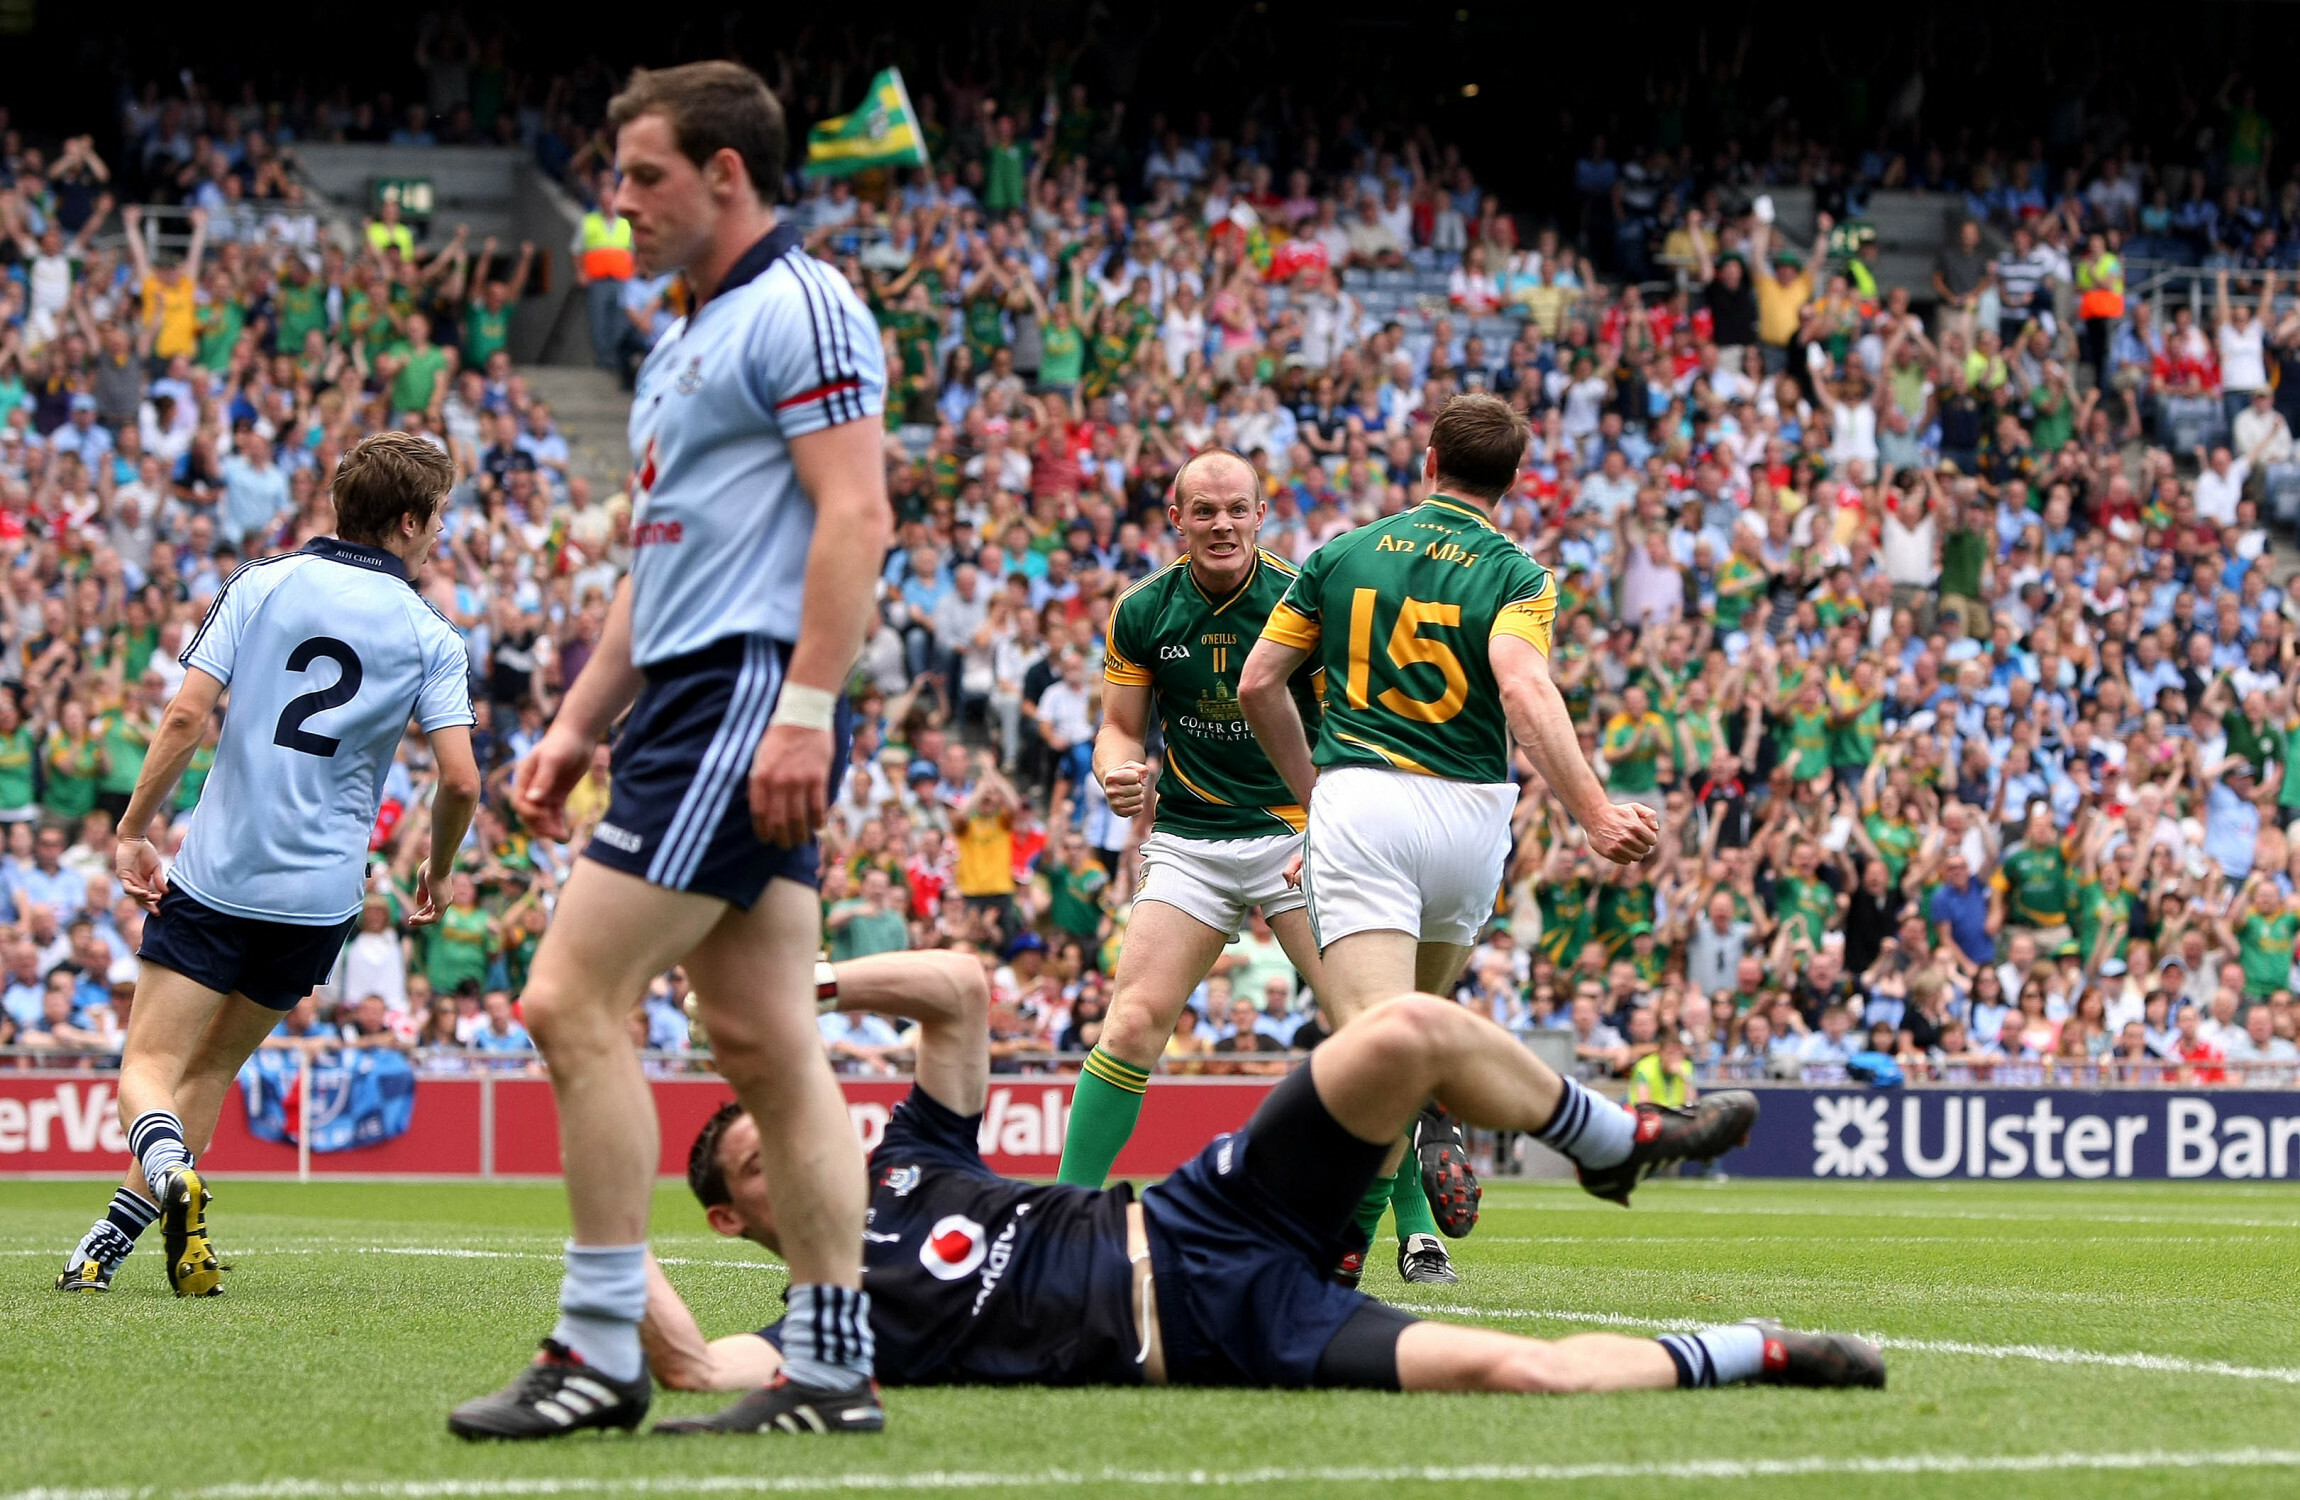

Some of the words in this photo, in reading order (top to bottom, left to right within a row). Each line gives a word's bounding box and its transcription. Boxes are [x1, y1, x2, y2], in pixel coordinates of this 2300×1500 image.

[1375, 533, 1417, 552] An
[1201, 633, 1237, 645] O'NEILLS
[1212, 647, 1227, 673] 11
[1346, 588, 1468, 723] 15
[273, 636, 363, 757] 2
[1901, 1095, 2149, 1179] Ulster
